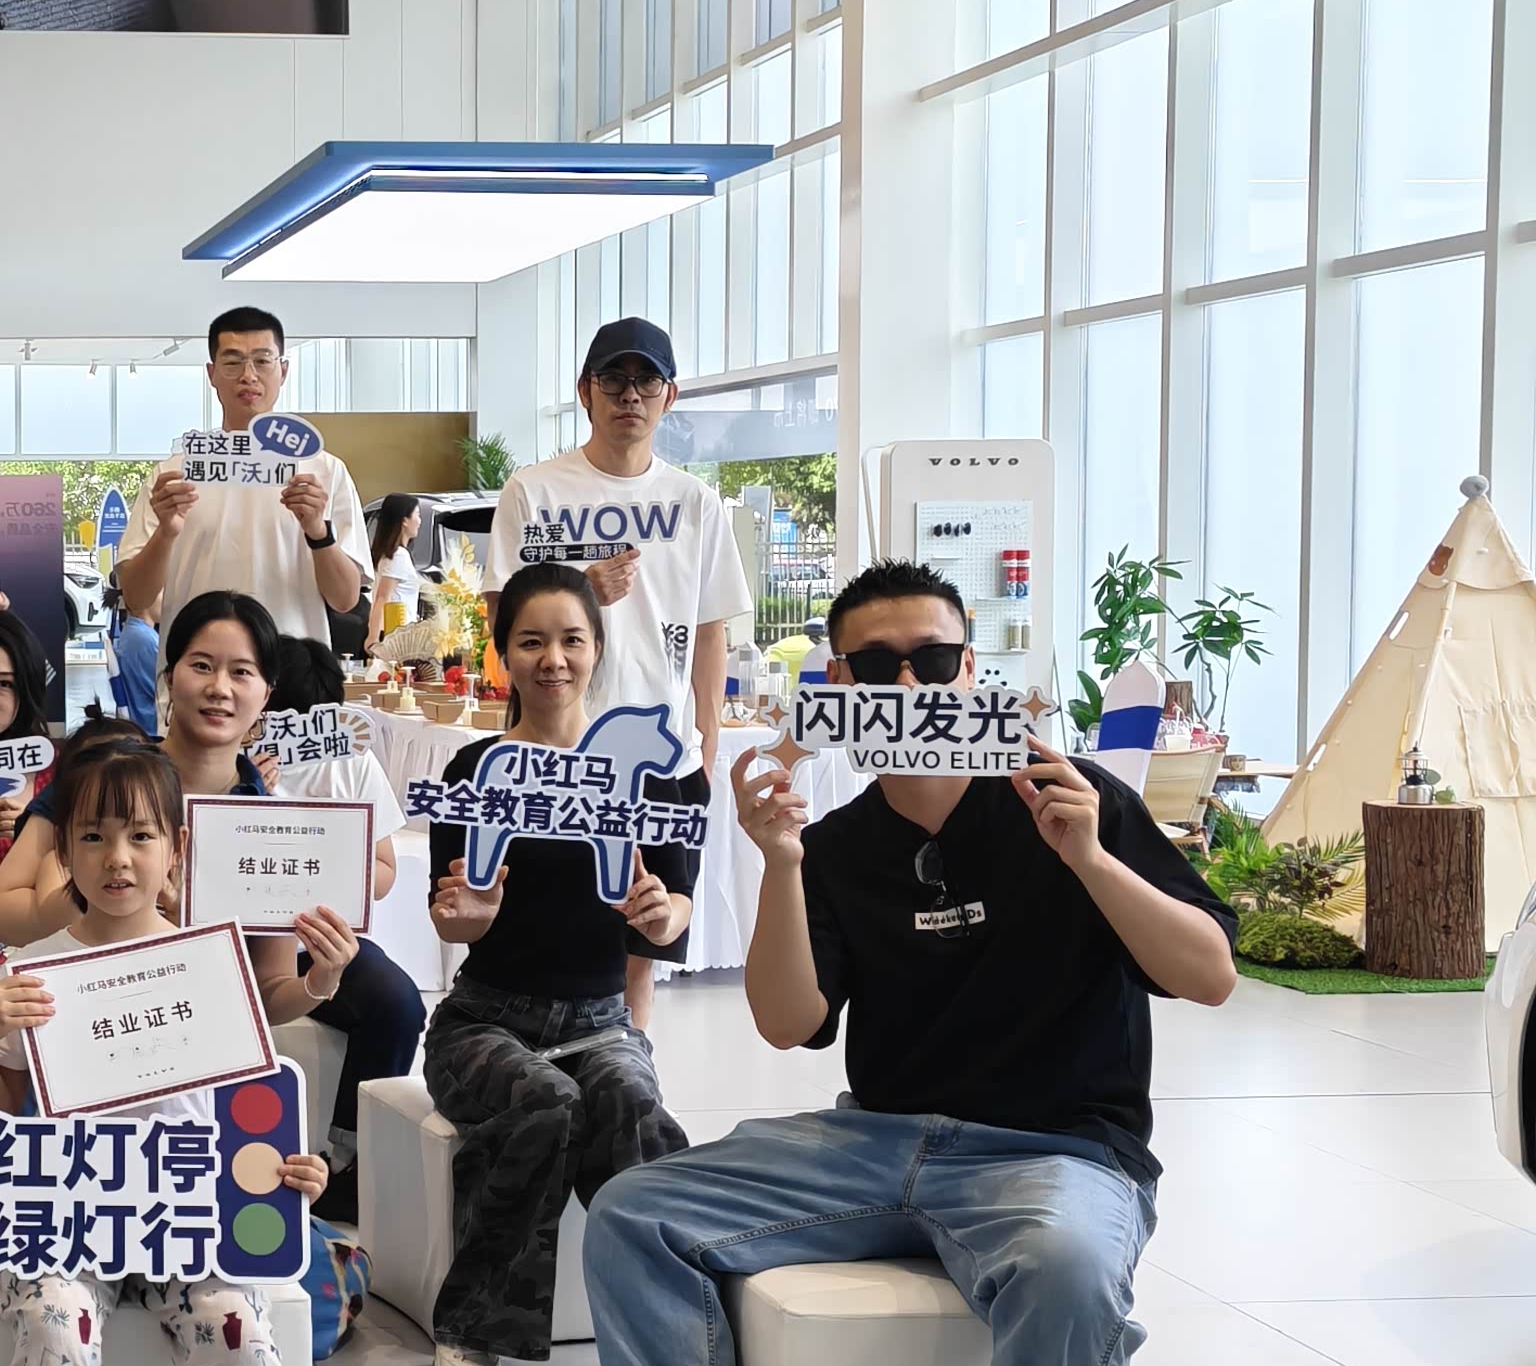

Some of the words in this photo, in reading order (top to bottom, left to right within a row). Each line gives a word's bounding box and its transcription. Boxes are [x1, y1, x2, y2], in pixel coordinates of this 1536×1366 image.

[185, 434, 251, 456] 在这里
[266, 420, 310, 456] Hej
[928, 457, 1020, 467] VOLVO
[524, 524, 565, 544] 热爱
[540, 504, 681, 541] WOW
[796, 690, 1021, 745] 闪闪发光
[504, 748, 616, 790] 小红马
[853, 750, 941, 770] VOLVO
[950, 750, 1022, 771] ELITE
[235, 825, 326, 835] 小红马安全教育公益行动
[406, 780, 707, 847] 安全教育公益行动
[238, 856, 321, 876] 结业证书
[77, 962, 187, 995] 小红马安全教育公益行动
[91, 1000, 194, 1041] 结业证书
